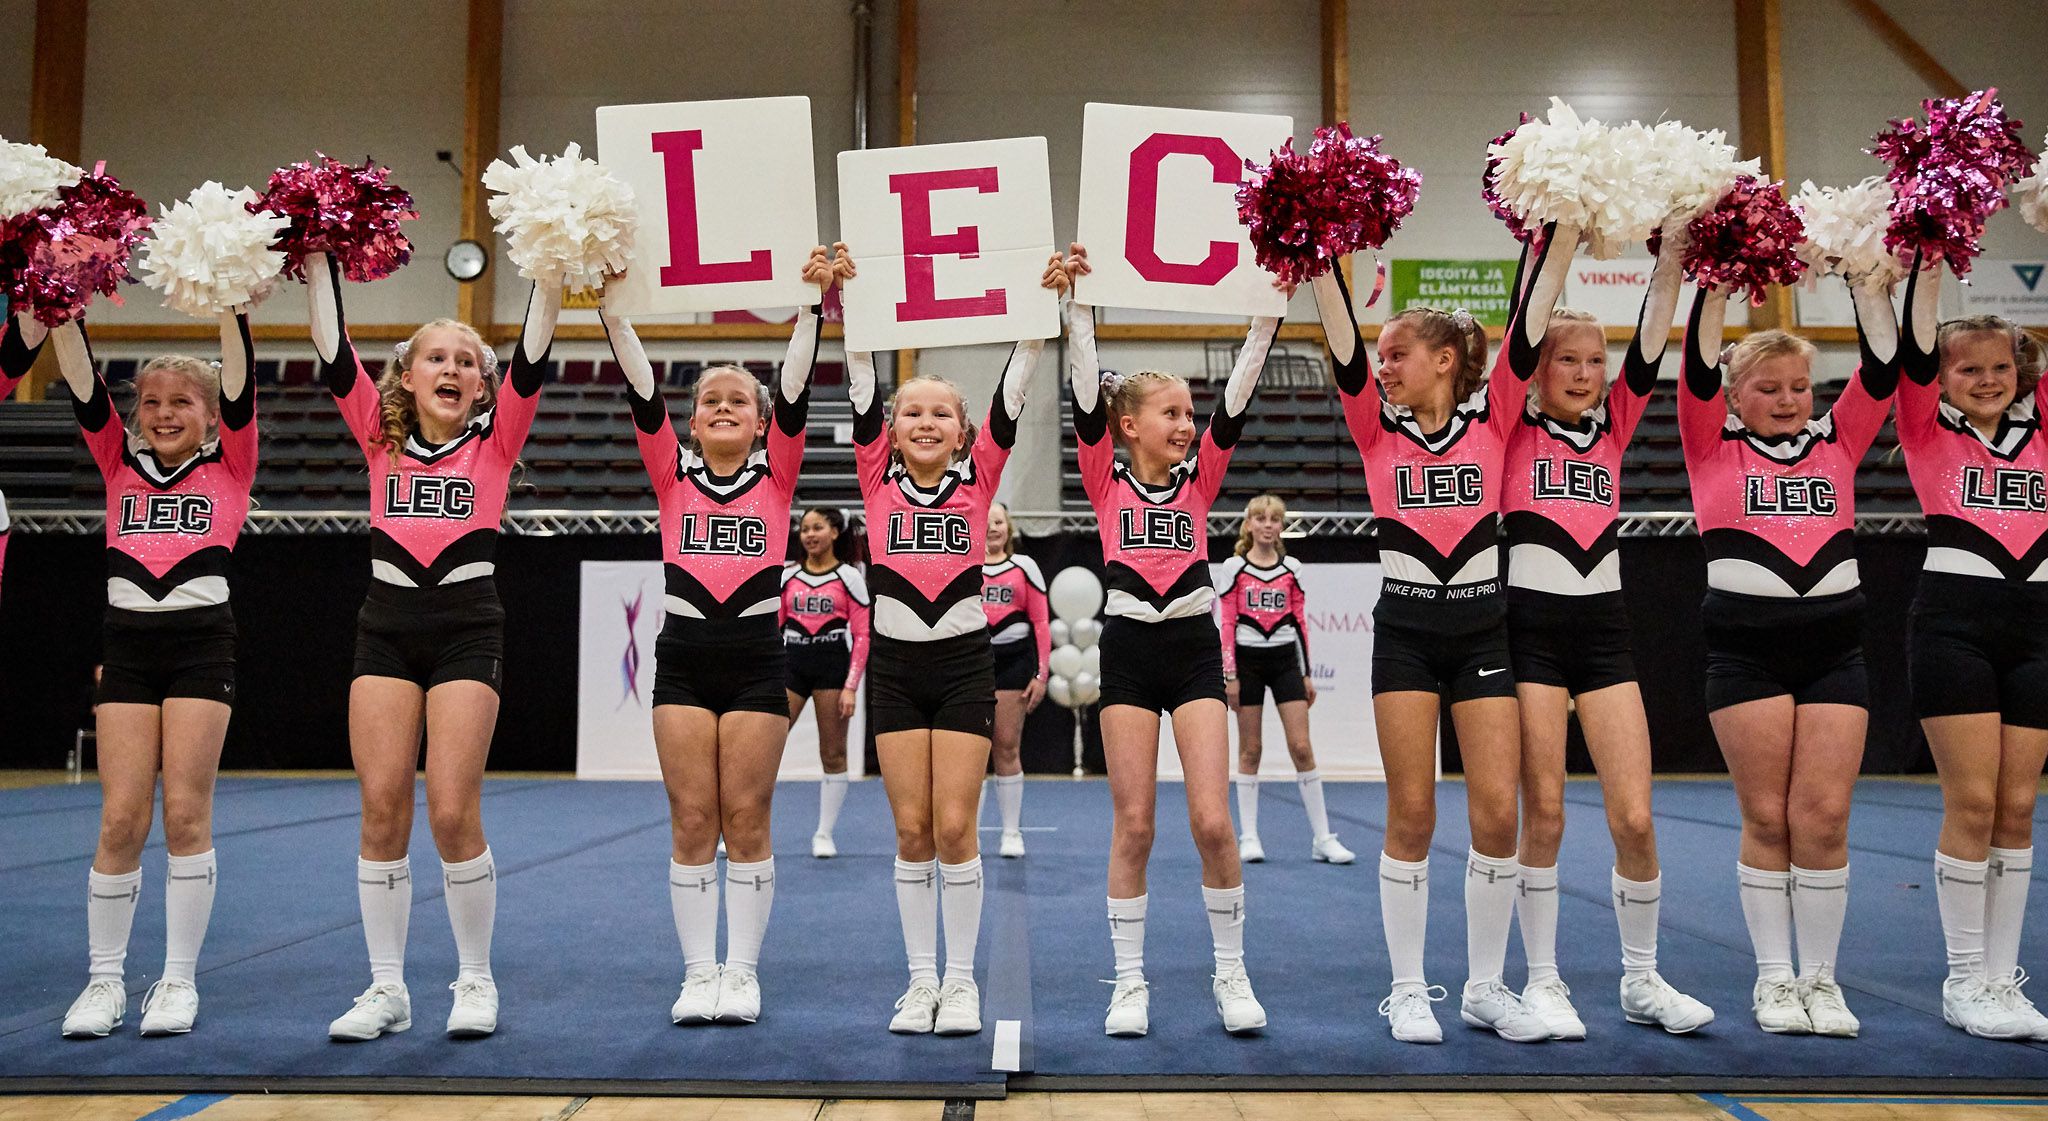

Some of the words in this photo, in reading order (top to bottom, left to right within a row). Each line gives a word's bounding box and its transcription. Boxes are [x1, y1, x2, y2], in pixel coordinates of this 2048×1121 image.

[651, 130, 773, 287] L
[1124, 132, 1242, 286] C
[889, 166, 1007, 321] E
[1418, 281, 1506, 295] ELÄMYKSIÄ
[1420, 268, 1478, 280] IDEOITA
[1483, 268, 1503, 280] JA
[1578, 271, 1646, 285] VIKING
[385, 474, 474, 520] LEC
[1396, 464, 1483, 509] LEC
[1534, 459, 1613, 507] LEC
[1745, 475, 1837, 517] LEC
[1962, 466, 2048, 512] LEC
[118, 494, 213, 536] LEC
[679, 513, 768, 556] LEC
[887, 512, 971, 555] LEC
[1120, 508, 1195, 552] LEC
[792, 595, 834, 614] LEC
[981, 585, 1013, 604] EC
[1245, 588, 1286, 610] LEC
[1384, 582, 1411, 596] NIKE
[1410, 588, 1436, 599] PRO
[1446, 587, 1475, 599] NIKE
[1476, 582, 1496, 596] PRO
